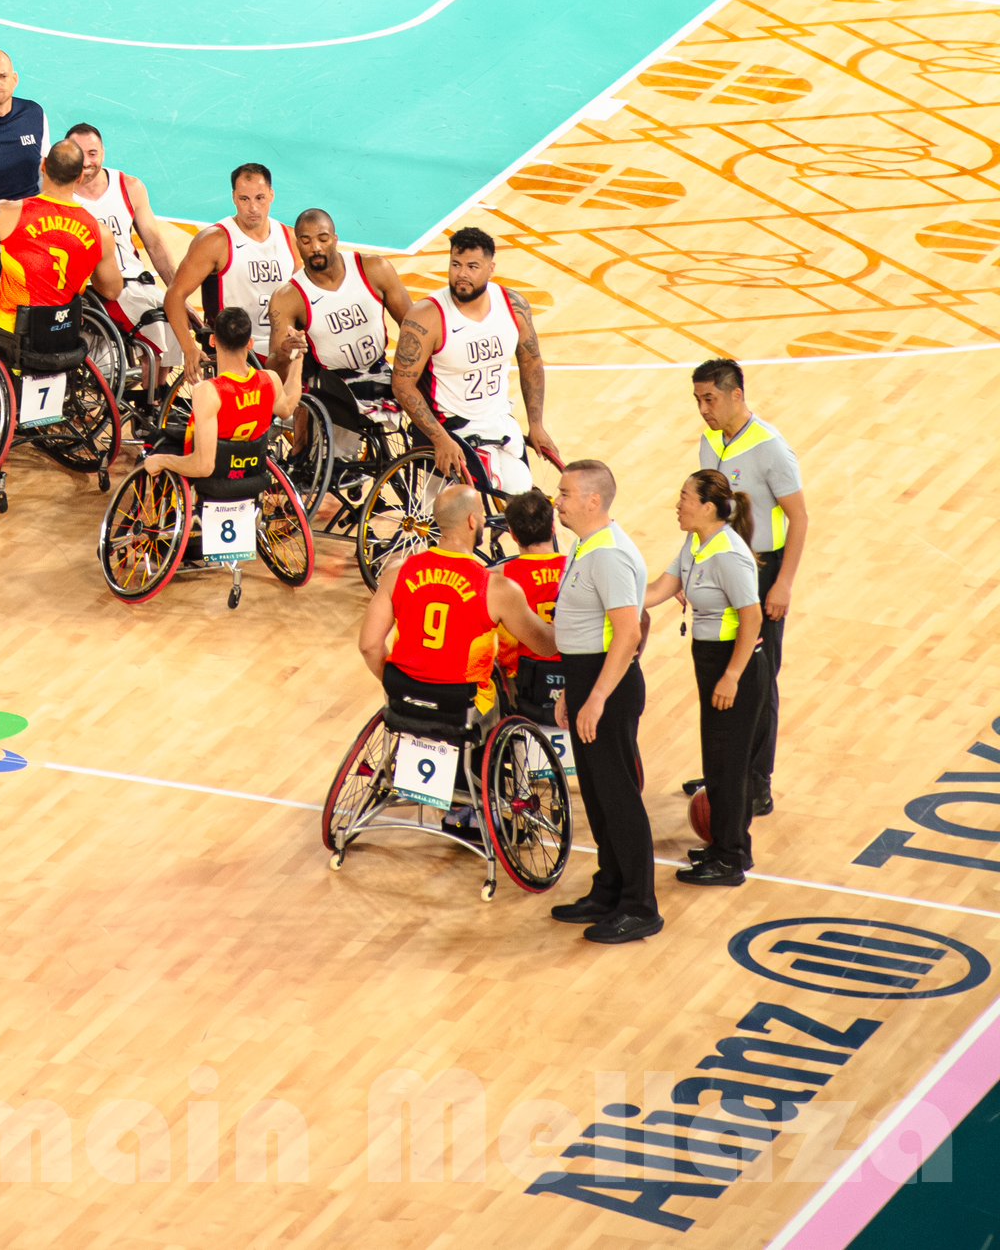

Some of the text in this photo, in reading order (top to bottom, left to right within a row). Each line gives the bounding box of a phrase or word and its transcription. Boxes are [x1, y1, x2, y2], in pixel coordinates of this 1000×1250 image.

[20, 133, 36, 147] USA
[48, 246, 70, 290] 7
[248, 260, 282, 282] USA
[50, 321, 73, 332] ELITE
[325, 303, 368, 334] USA
[340, 335, 377, 370] 16
[466, 335, 503, 363] USA
[463, 364, 502, 401] 25
[38, 388, 51, 410] 7
[220, 519, 237, 543] 8
[422, 601, 450, 650] 9
[411, 738, 436, 752] Allianz
[551, 734, 567, 758] 5
[417, 758, 436, 784] 9
[852, 715, 1000, 872] TOY
[524, 1002, 884, 1233] Allianz
